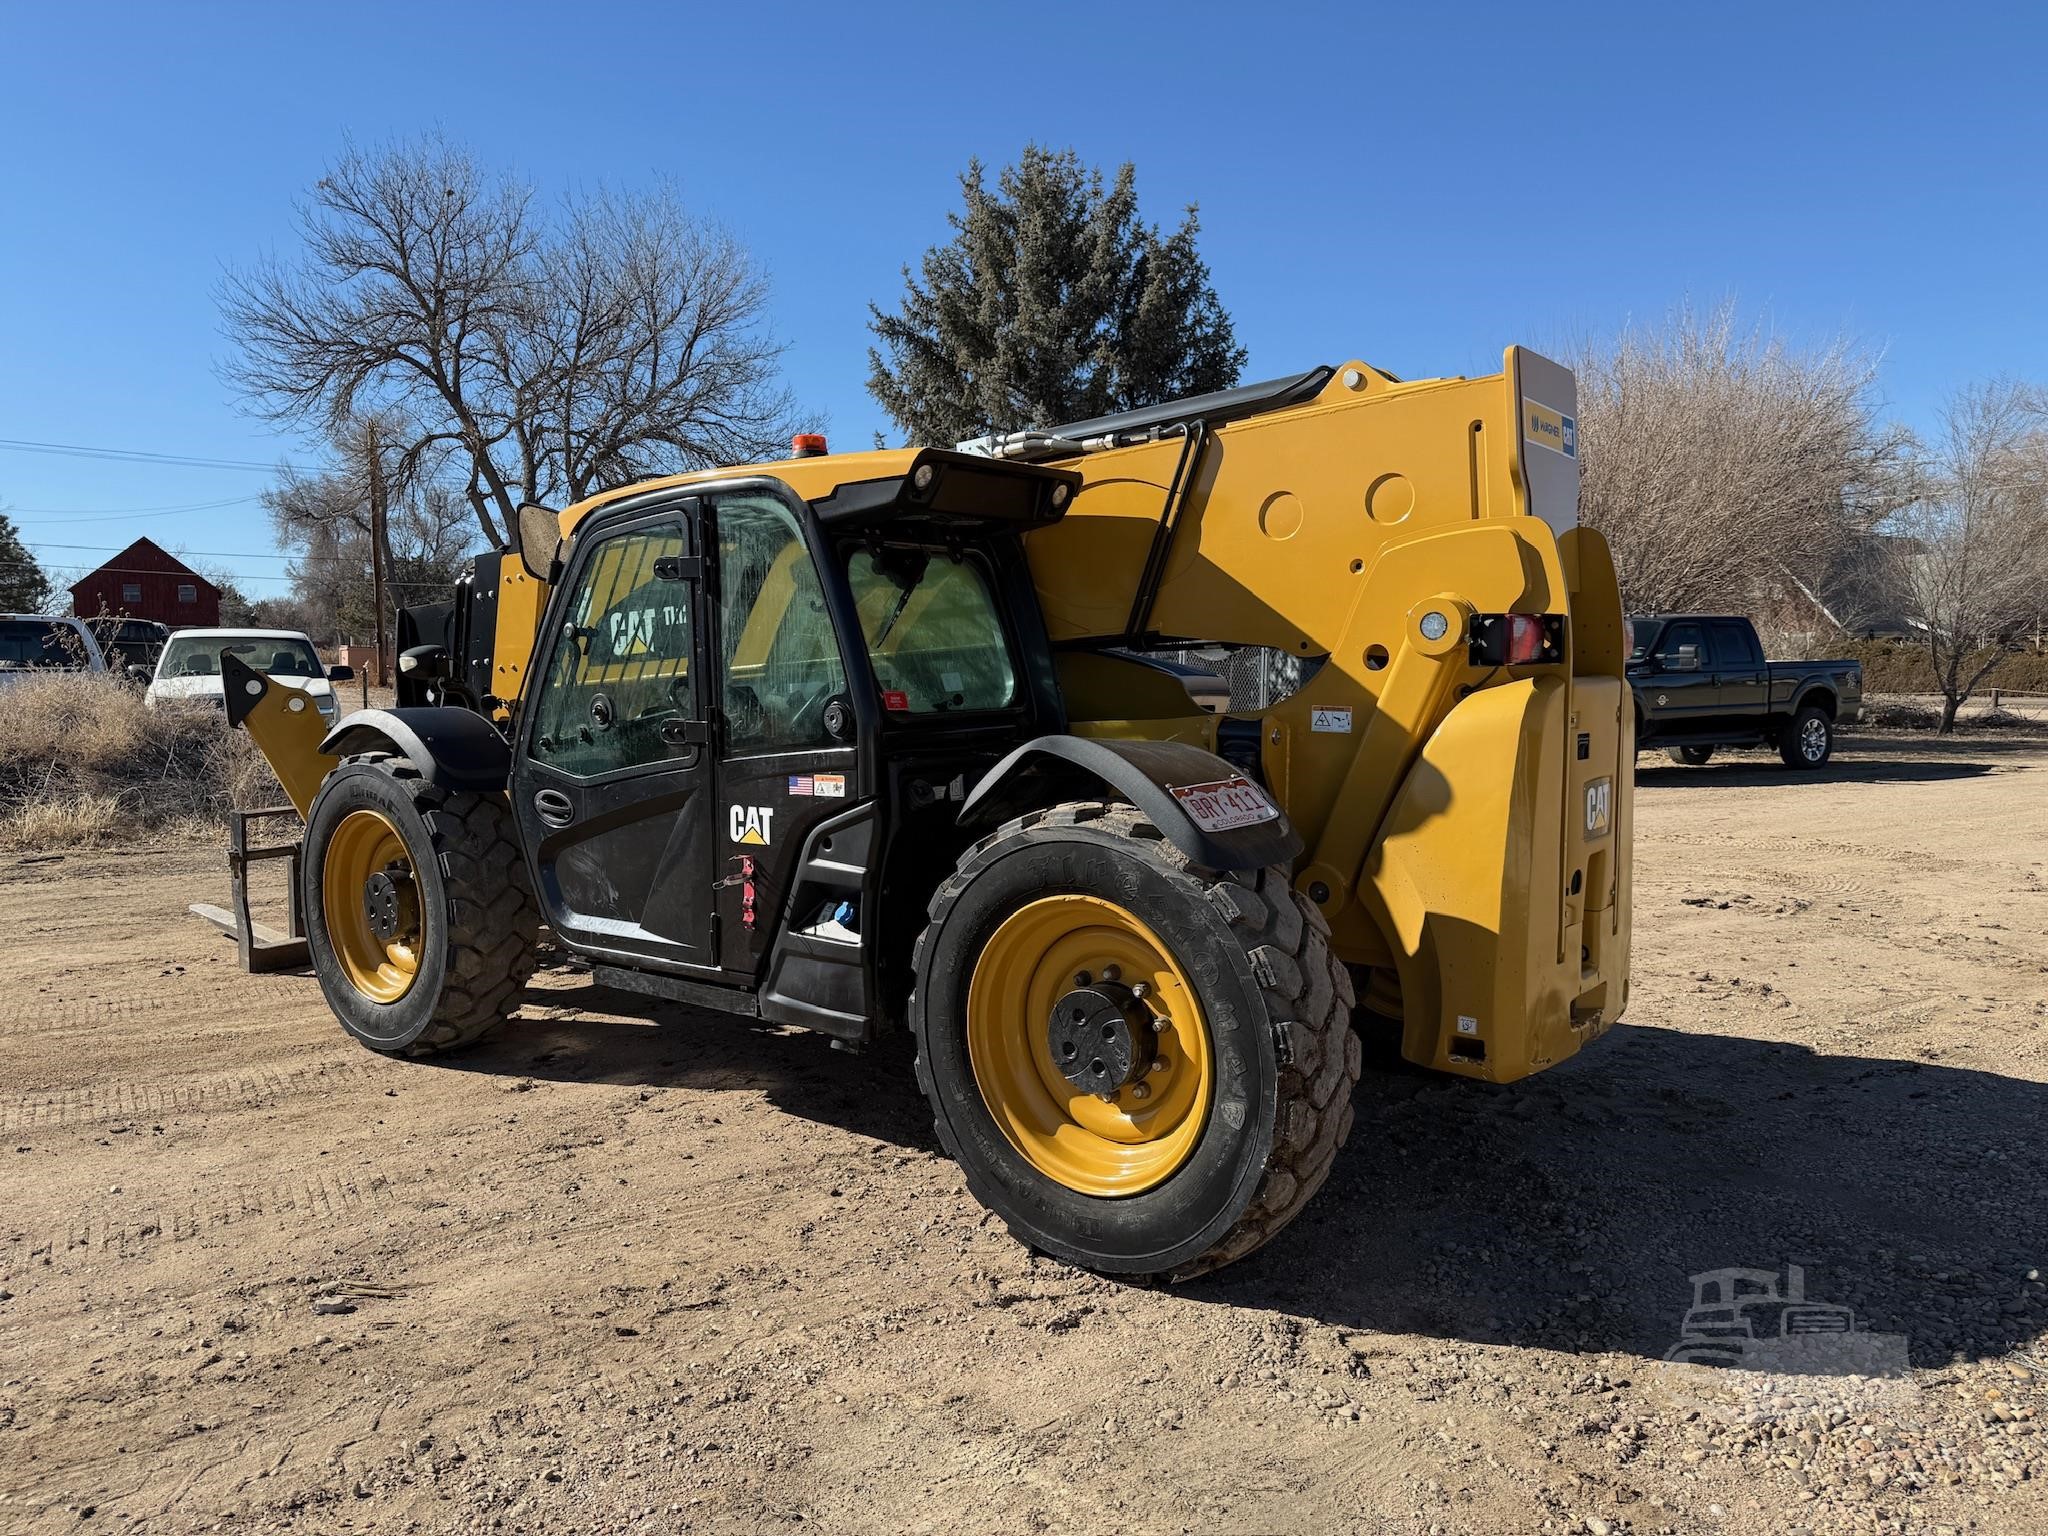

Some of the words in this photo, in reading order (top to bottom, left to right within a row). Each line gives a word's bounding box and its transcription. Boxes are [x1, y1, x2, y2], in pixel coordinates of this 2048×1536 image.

[610, 608, 655, 656] CAT
[729, 804, 774, 846] CAT
[1216, 814, 1255, 827] COLORADO
[1586, 783, 1610, 832] CAT
